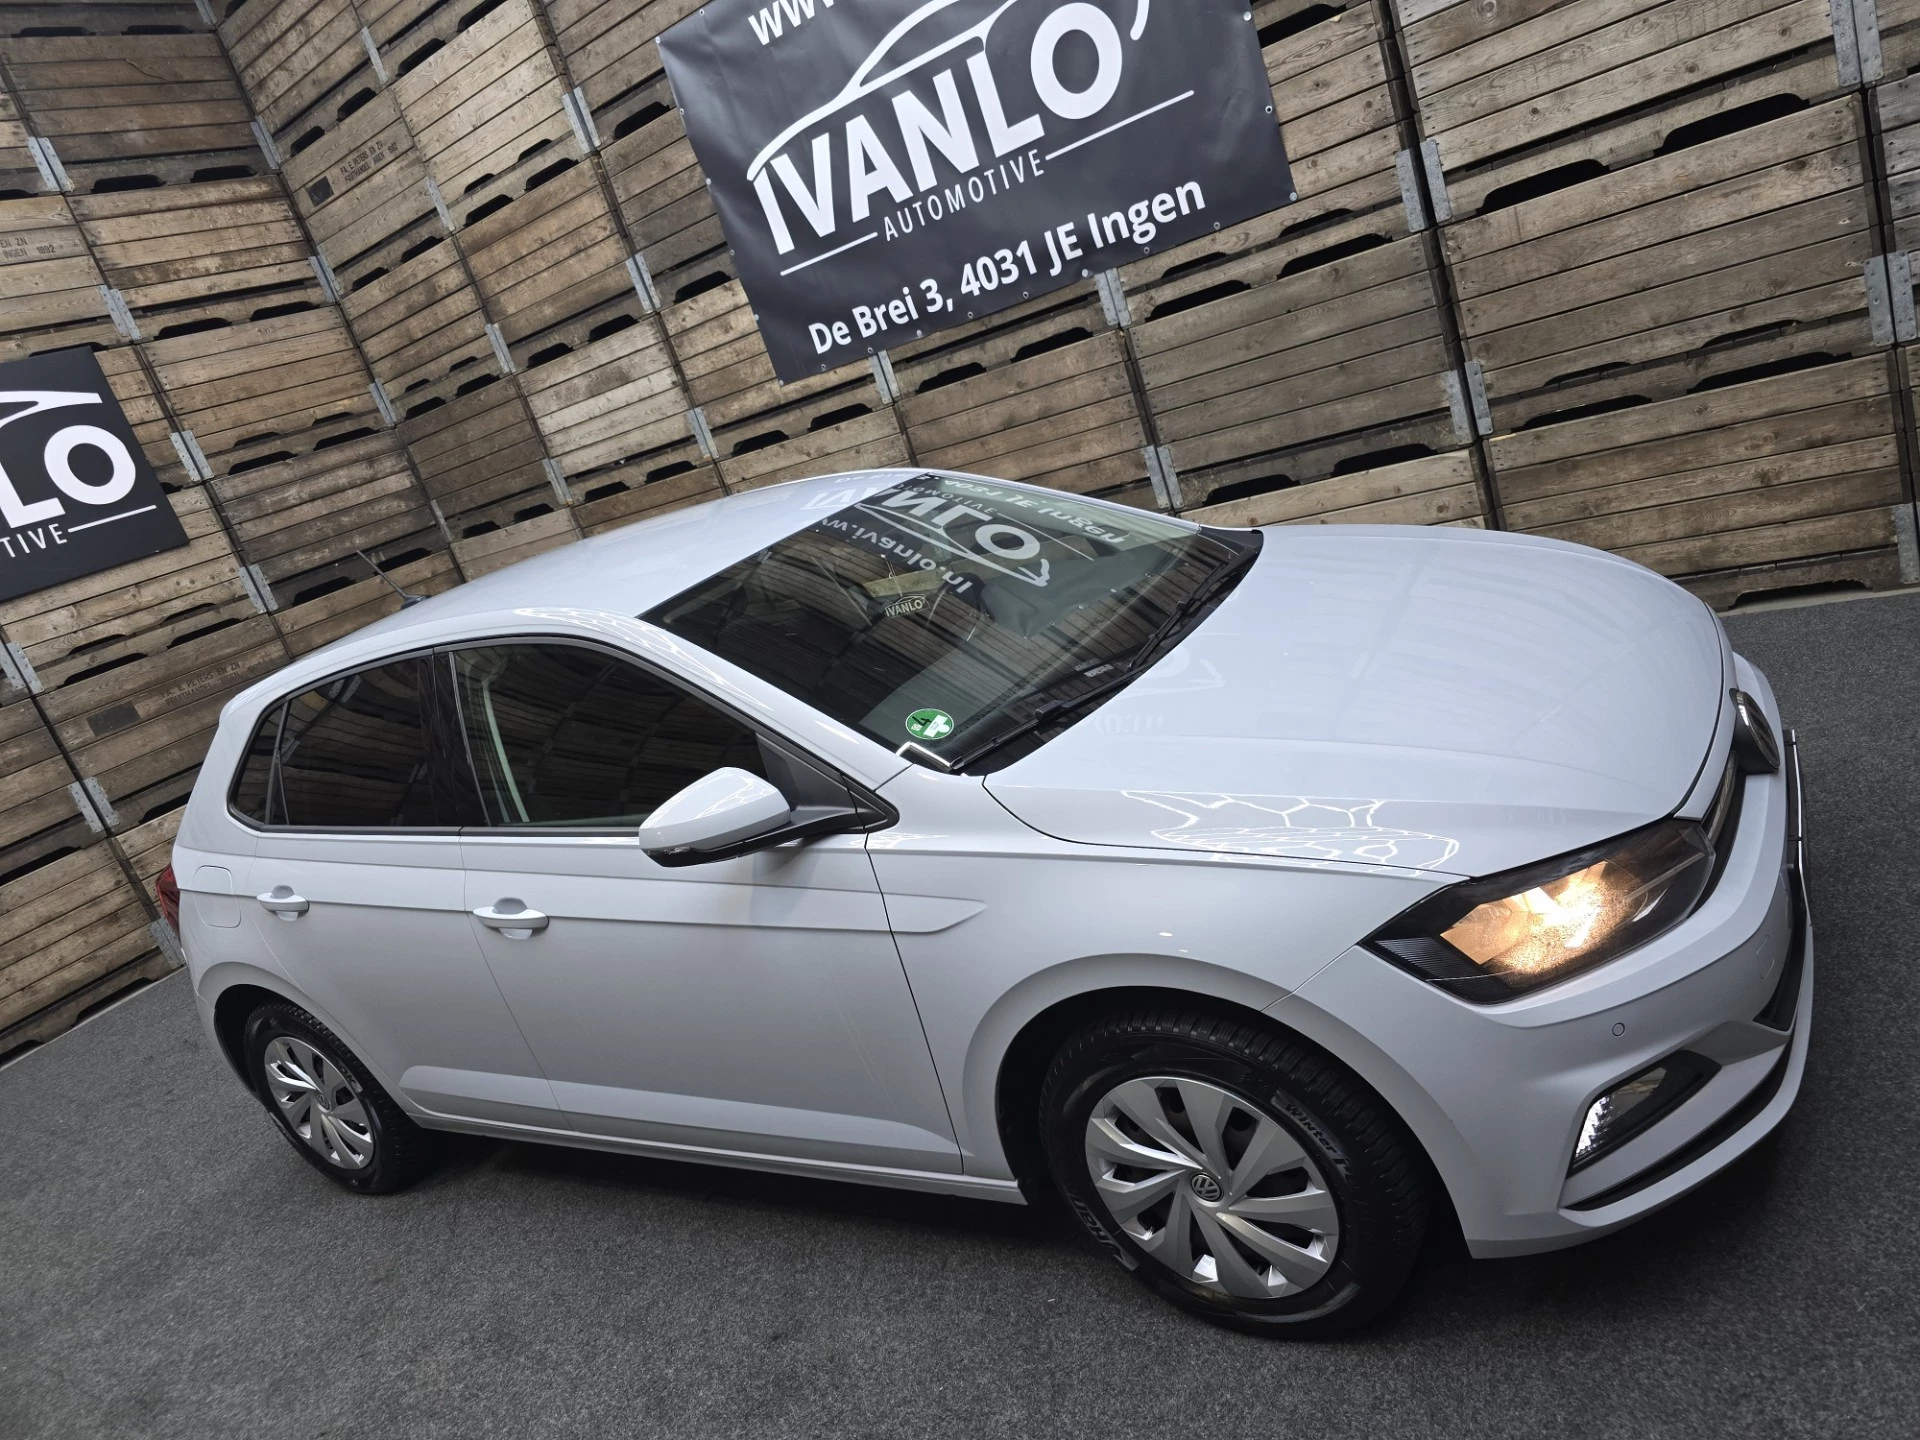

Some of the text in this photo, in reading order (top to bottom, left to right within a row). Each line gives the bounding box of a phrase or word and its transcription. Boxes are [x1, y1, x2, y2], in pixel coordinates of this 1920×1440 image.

[747, 0, 834, 46] ww
[753, 2, 1122, 255] IVANLO
[883, 149, 1045, 242] AUTOMOTIVE
[808, 182, 1206, 355] De Brei 3, 4031 JE Ingen
[885, 599, 923, 617] IVANLO
